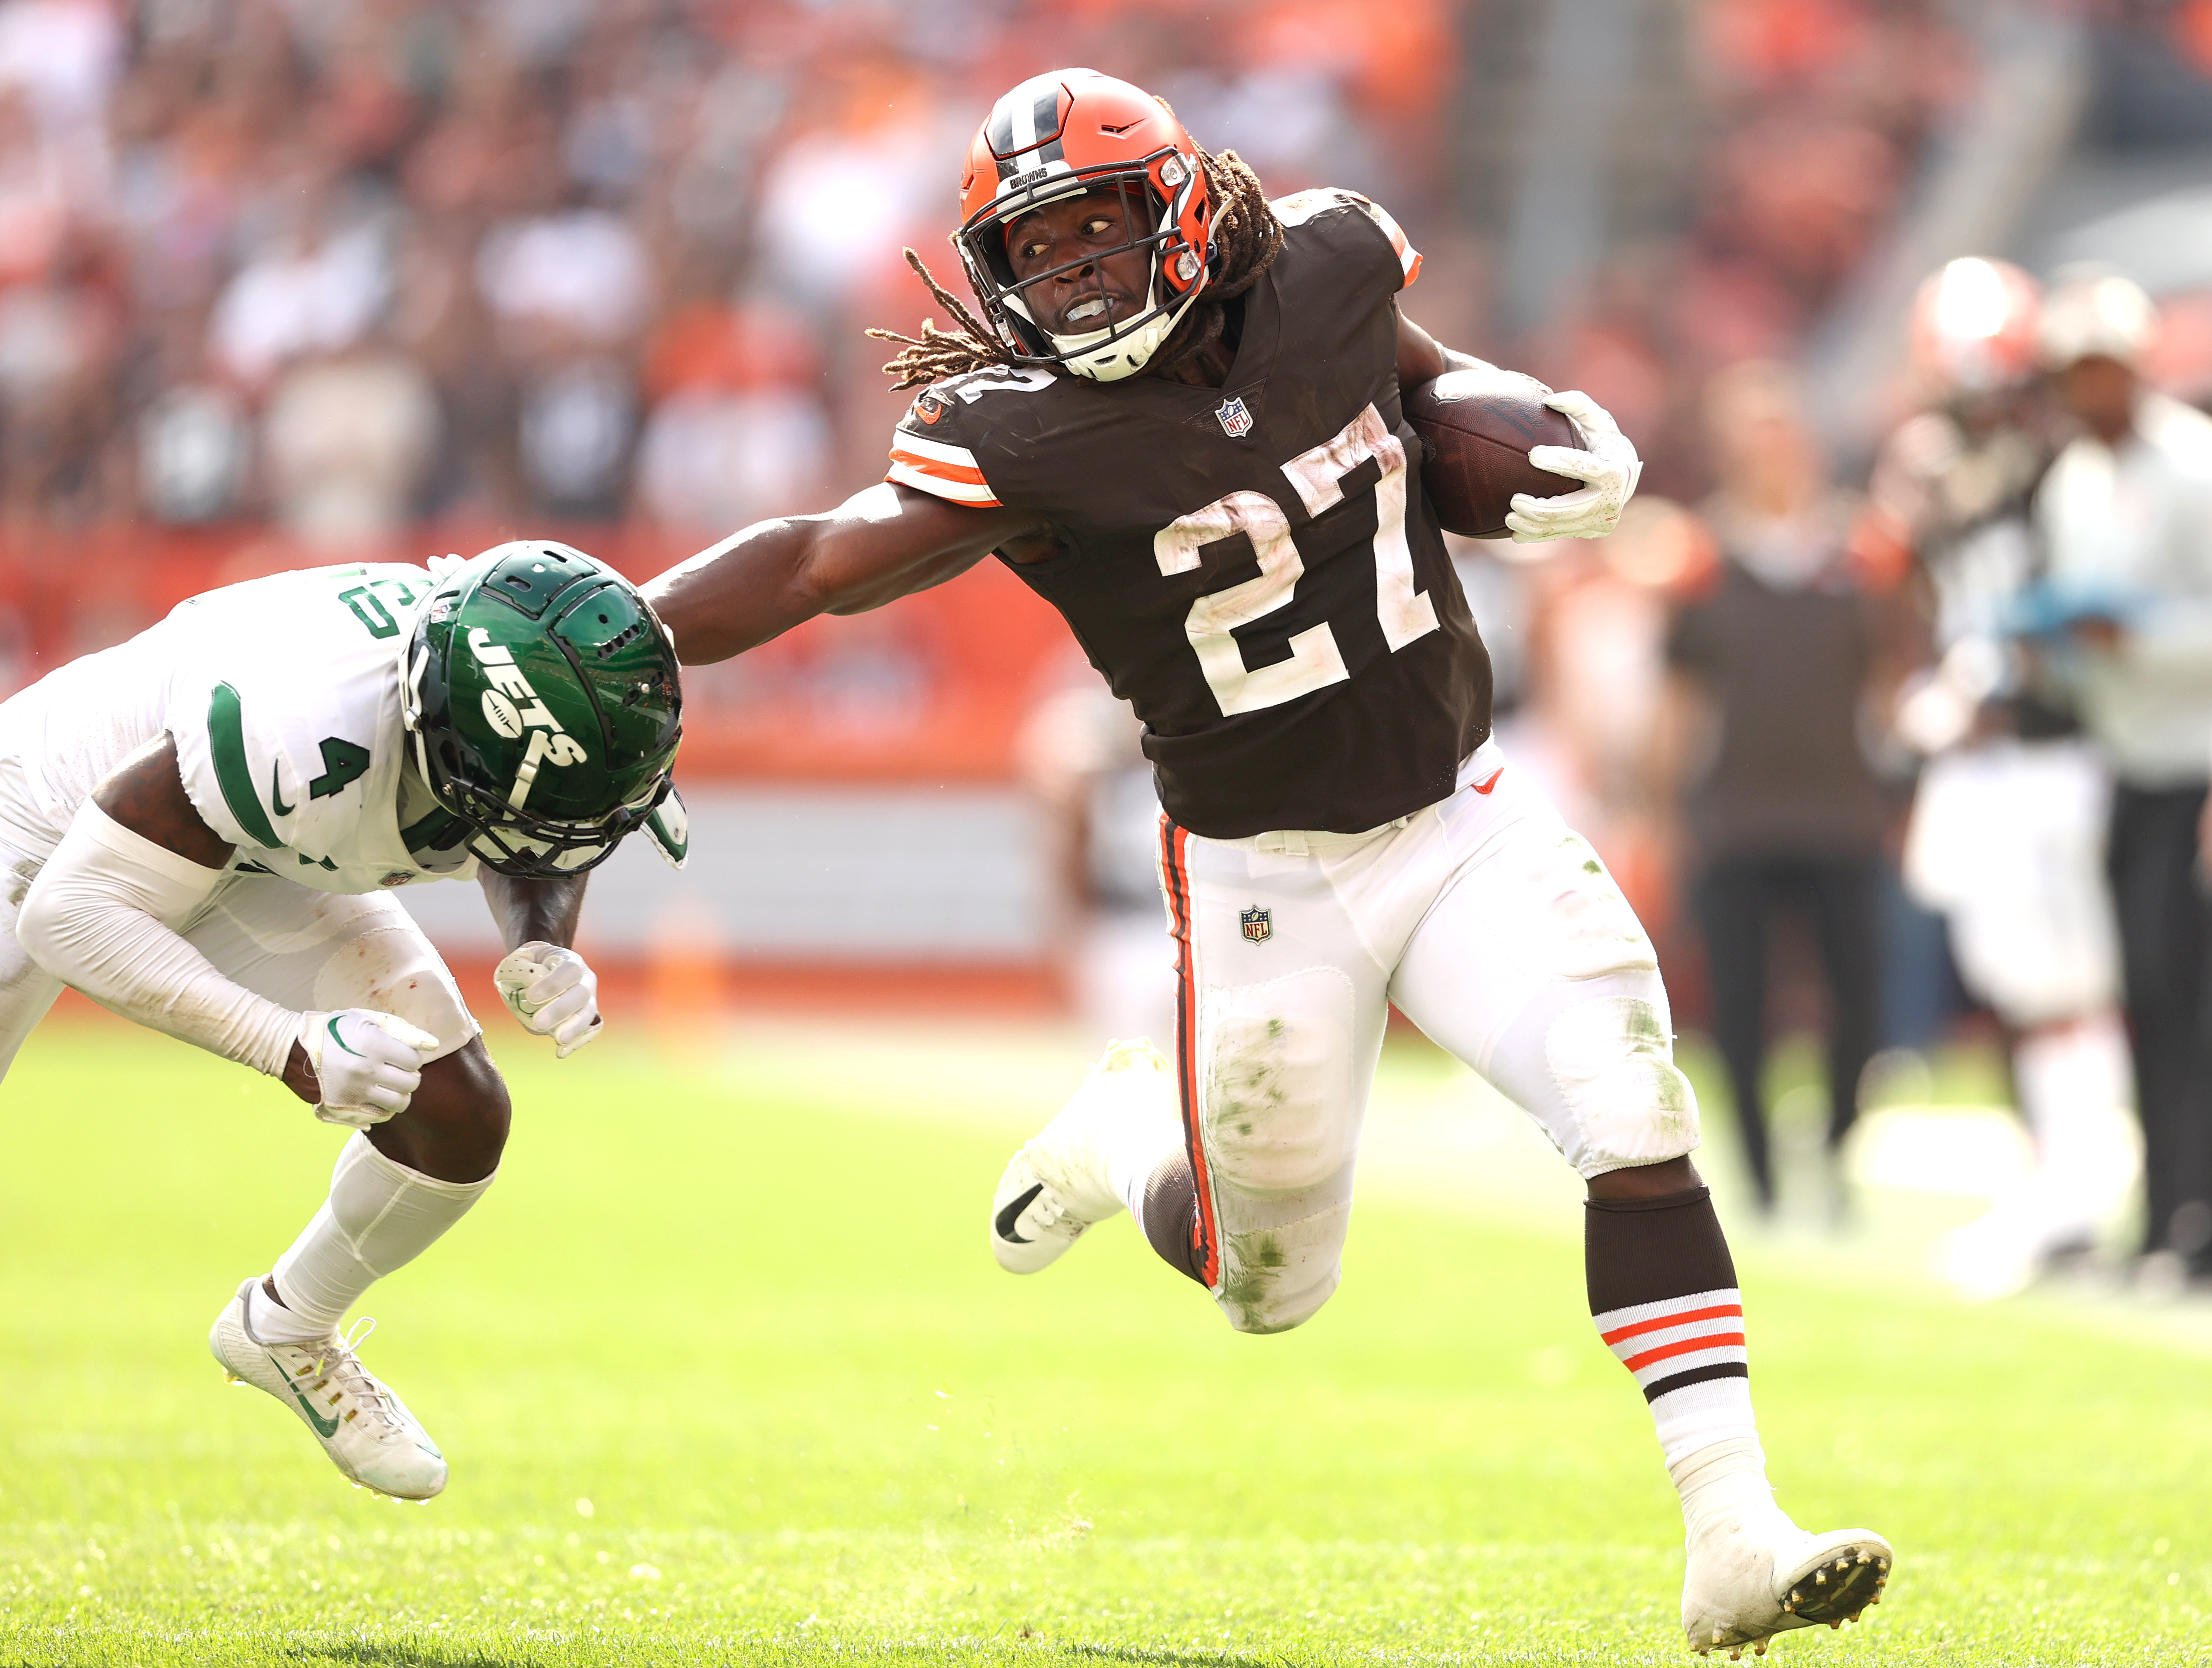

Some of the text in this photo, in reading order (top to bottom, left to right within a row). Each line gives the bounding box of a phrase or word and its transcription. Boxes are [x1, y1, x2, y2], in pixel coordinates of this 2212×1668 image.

[1010, 167, 1048, 189] BROWNS
[1226, 413, 1249, 432] NFL
[1154, 402, 1440, 717] 27
[467, 627, 588, 767] JETS
[309, 736, 370, 801] 4
[1246, 923, 1267, 938] NFL
